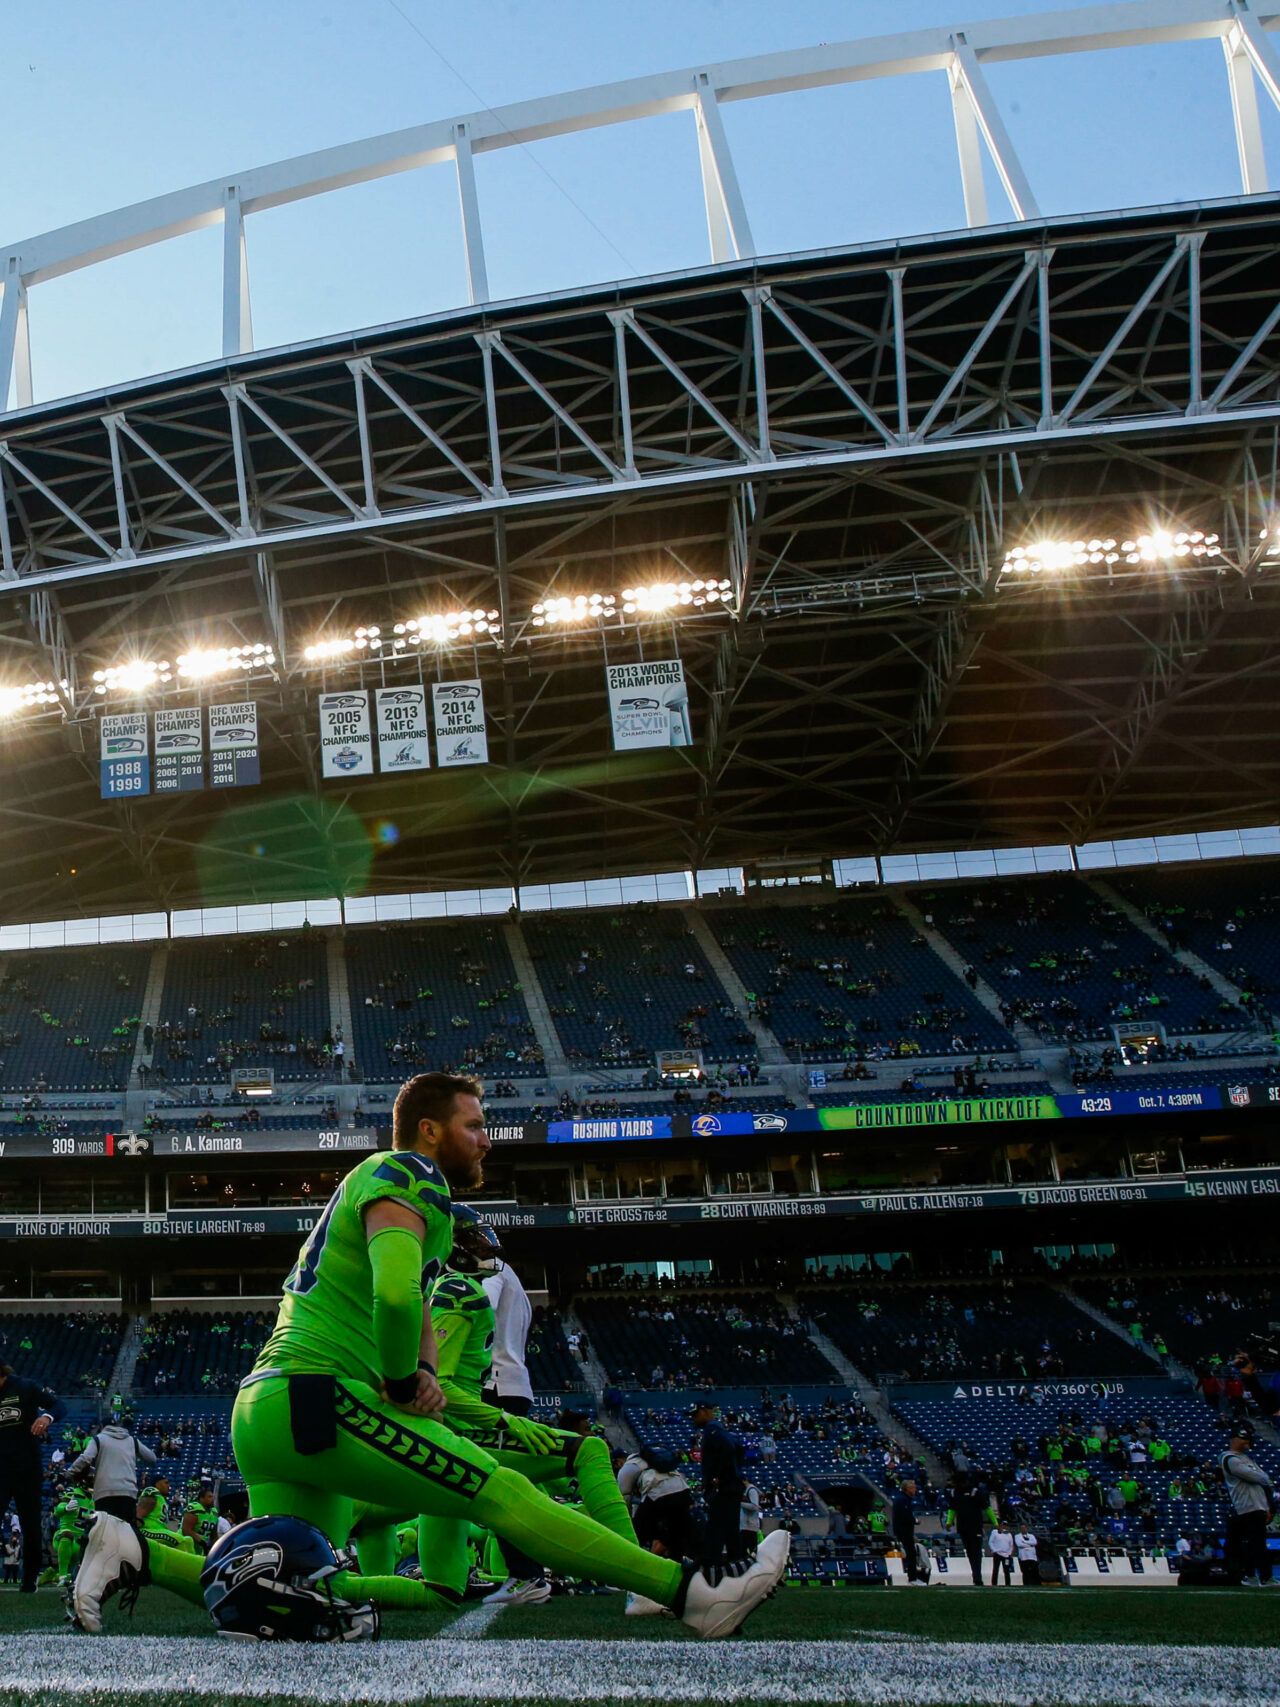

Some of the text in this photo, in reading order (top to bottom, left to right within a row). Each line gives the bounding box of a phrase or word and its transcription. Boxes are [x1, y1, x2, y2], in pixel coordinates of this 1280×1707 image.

[610, 662, 680, 679] 2013 WORLD
[611, 673, 681, 689] CHAMPIONS
[211, 703, 255, 715] NFC WEST
[385, 706, 418, 721] 2013
[442, 700, 476, 715] 2014
[102, 714, 146, 728] AFC WEST
[156, 709, 201, 721] NFC WEST
[211, 713, 255, 727] CHAMPS
[328, 711, 361, 725] 2005
[448, 714, 472, 726] NFC
[102, 724, 146, 738] CHAMPS
[156, 719, 200, 732] CHAMPS
[333, 724, 357, 736] NFC
[390, 720, 414, 731] NFC
[436, 724, 485, 737] CHAMPIONS
[614, 716, 668, 732] XLVIII
[322, 733, 370, 746] CHAMPIONS
[379, 729, 427, 742] CHAMPIONS
[621, 729, 663, 737] CHAMPIONS
[181, 755, 202, 764] 2007
[213, 752, 233, 761] 2013
[236, 750, 257, 758] 2020
[156, 757, 177, 766] 2004
[213, 763, 233, 772] 2014
[108, 761, 142, 777] 1988
[156, 768, 177, 777] 2005
[181, 766, 202, 775] 2010
[109, 777, 142, 792] 1999
[238, 1070, 268, 1078] 332
[810, 1076, 826, 1088] 12
[1081, 1097, 1112, 1112] 43:29
[1138, 1095, 1157, 1108] Oct.
[1167, 1093, 1202, 1106] 4:38PM
[1231, 1094, 1248, 1104] NFL
[855, 1099, 1041, 1127] COUNTDOWN TO KICKOFF
[489, 1126, 524, 1141] LEADERS
[573, 1120, 653, 1139] RUSHING YARDS
[52, 1138, 104, 1154] 309 YARDS
[171, 1135, 242, 1152] 6. A. Kamara
[318, 1132, 369, 1148] 297 YARDS
[1184, 1182, 1207, 1196] 45
[1207, 1180, 1248, 1196] KENNY
[879, 1196, 908, 1211] PAUL
[910, 1195, 921, 1210] G.
[923, 1194, 957, 1209] ALLEN
[958, 1196, 983, 1208] 97-18
[1019, 1187, 1148, 1205] 79 JACOB GREEN 80-91
[577, 1209, 667, 1224] PETE GROSS 76-92
[701, 1202, 826, 1218] 28 CURT WARNER 83-89
[143, 1220, 265, 1234] 80 STEVE LARGENT 76-89
[297, 1218, 314, 1232] 10
[511, 1214, 535, 1226] 76-86
[16, 1222, 111, 1236] RING OF HONOR
[1091, 1383, 1124, 1396] CUB
[532, 1396, 562, 1407] CLUB
